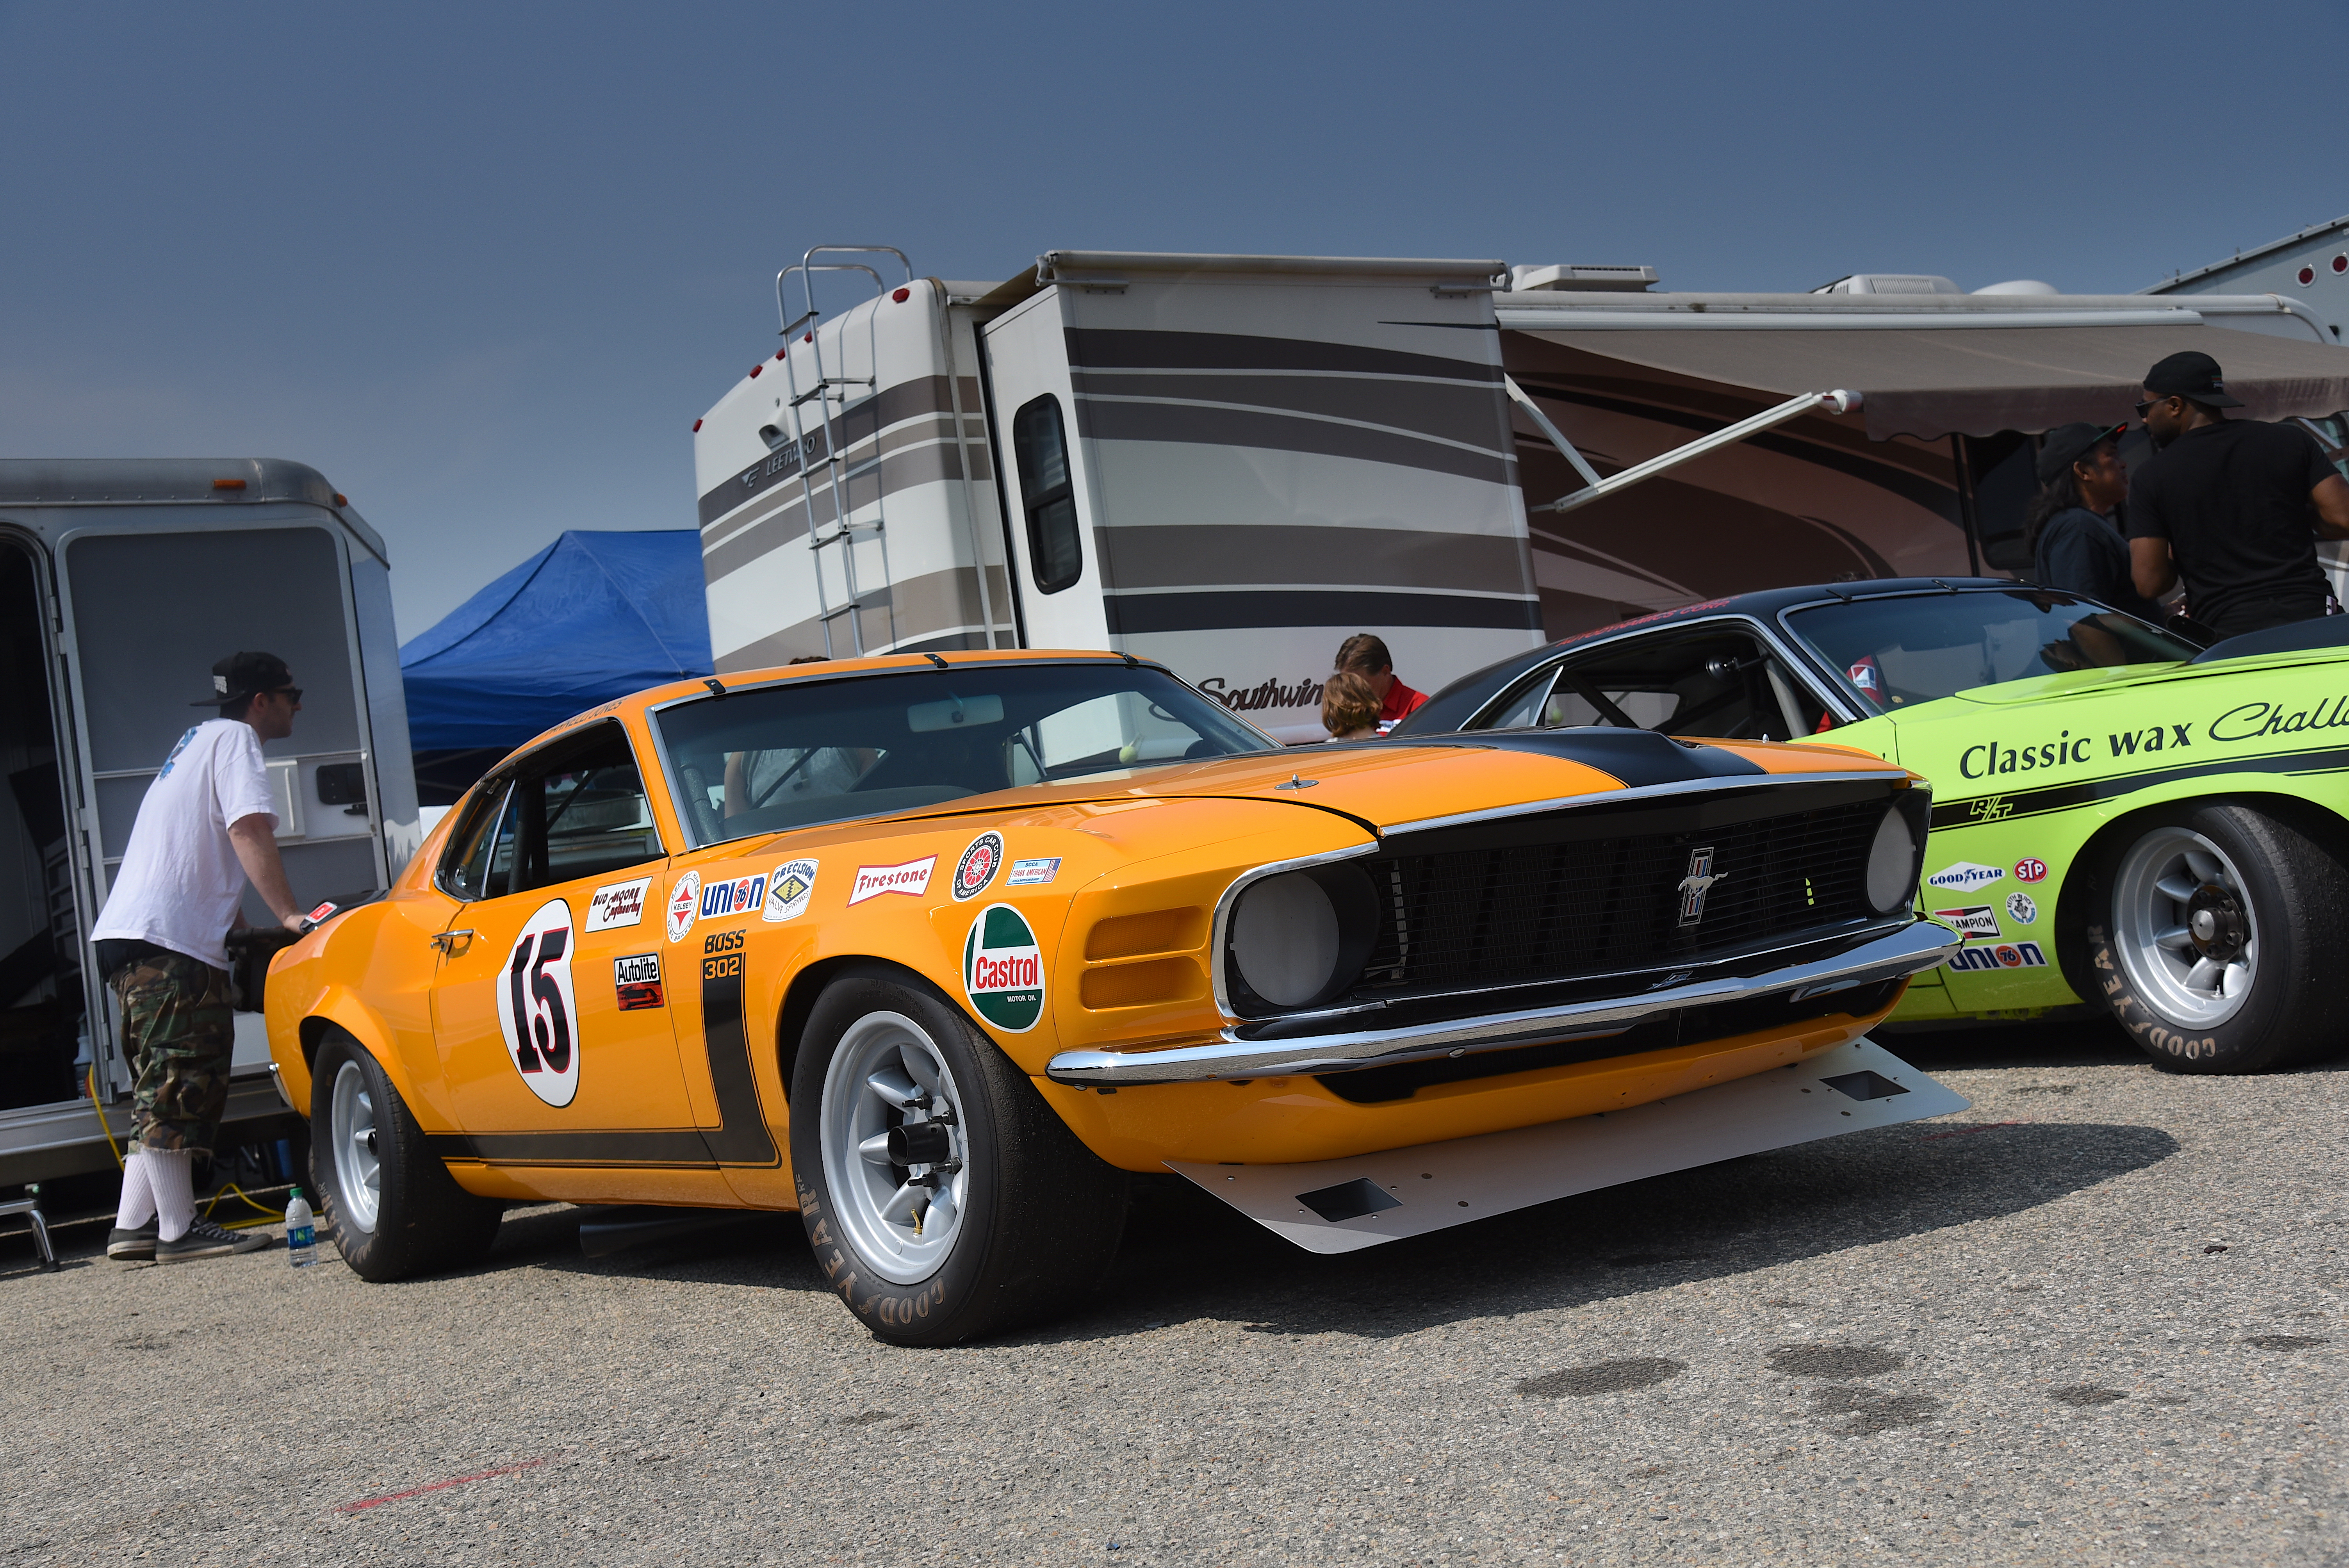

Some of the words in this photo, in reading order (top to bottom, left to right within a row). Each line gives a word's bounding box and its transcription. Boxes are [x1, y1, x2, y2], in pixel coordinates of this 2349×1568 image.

[1198, 677, 1324, 711] Southwin
[1959, 730, 2091, 780] Classic
[2108, 722, 2193, 757] wax
[1970, 797, 2013, 821] R/T
[959, 838, 984, 871] SPORTS
[985, 836, 996, 846] CAR
[774, 862, 815, 884] PRECISION
[857, 869, 927, 893] Firestone
[1012, 869, 1026, 877] TRANS
[1026, 868, 1047, 876] AMERICAN
[1930, 869, 2002, 885] GOODYEAR
[2018, 860, 2044, 879] STP
[736, 885, 747, 904] 76
[956, 878, 962, 889] OF
[958, 879, 989, 896] AMERICA
[592, 893, 608, 906] BUD
[611, 887, 641, 903] MOORE
[674, 901, 693, 911] KELSEY
[769, 895, 784, 914] VALVE
[784, 890, 809, 914] SPRINGS
[2007, 894, 2017, 908] KEITH
[2017, 893, 2032, 905] BLACK
[603, 896, 642, 923] Engineering
[1951, 916, 1993, 929] AMPION
[704, 929, 747, 955] BOSS
[2000, 949, 2016, 962] 76
[618, 957, 658, 983] Autolite
[704, 957, 740, 980] 302
[975, 953, 1039, 989] Castrol
[510, 926, 571, 1074] 15
[870, 979, 889, 990] BLUE
[895, 985, 925, 1015] STREAK
[796, 1173, 806, 1192] RF
[800, 1187, 945, 1325] GOODYEAR
